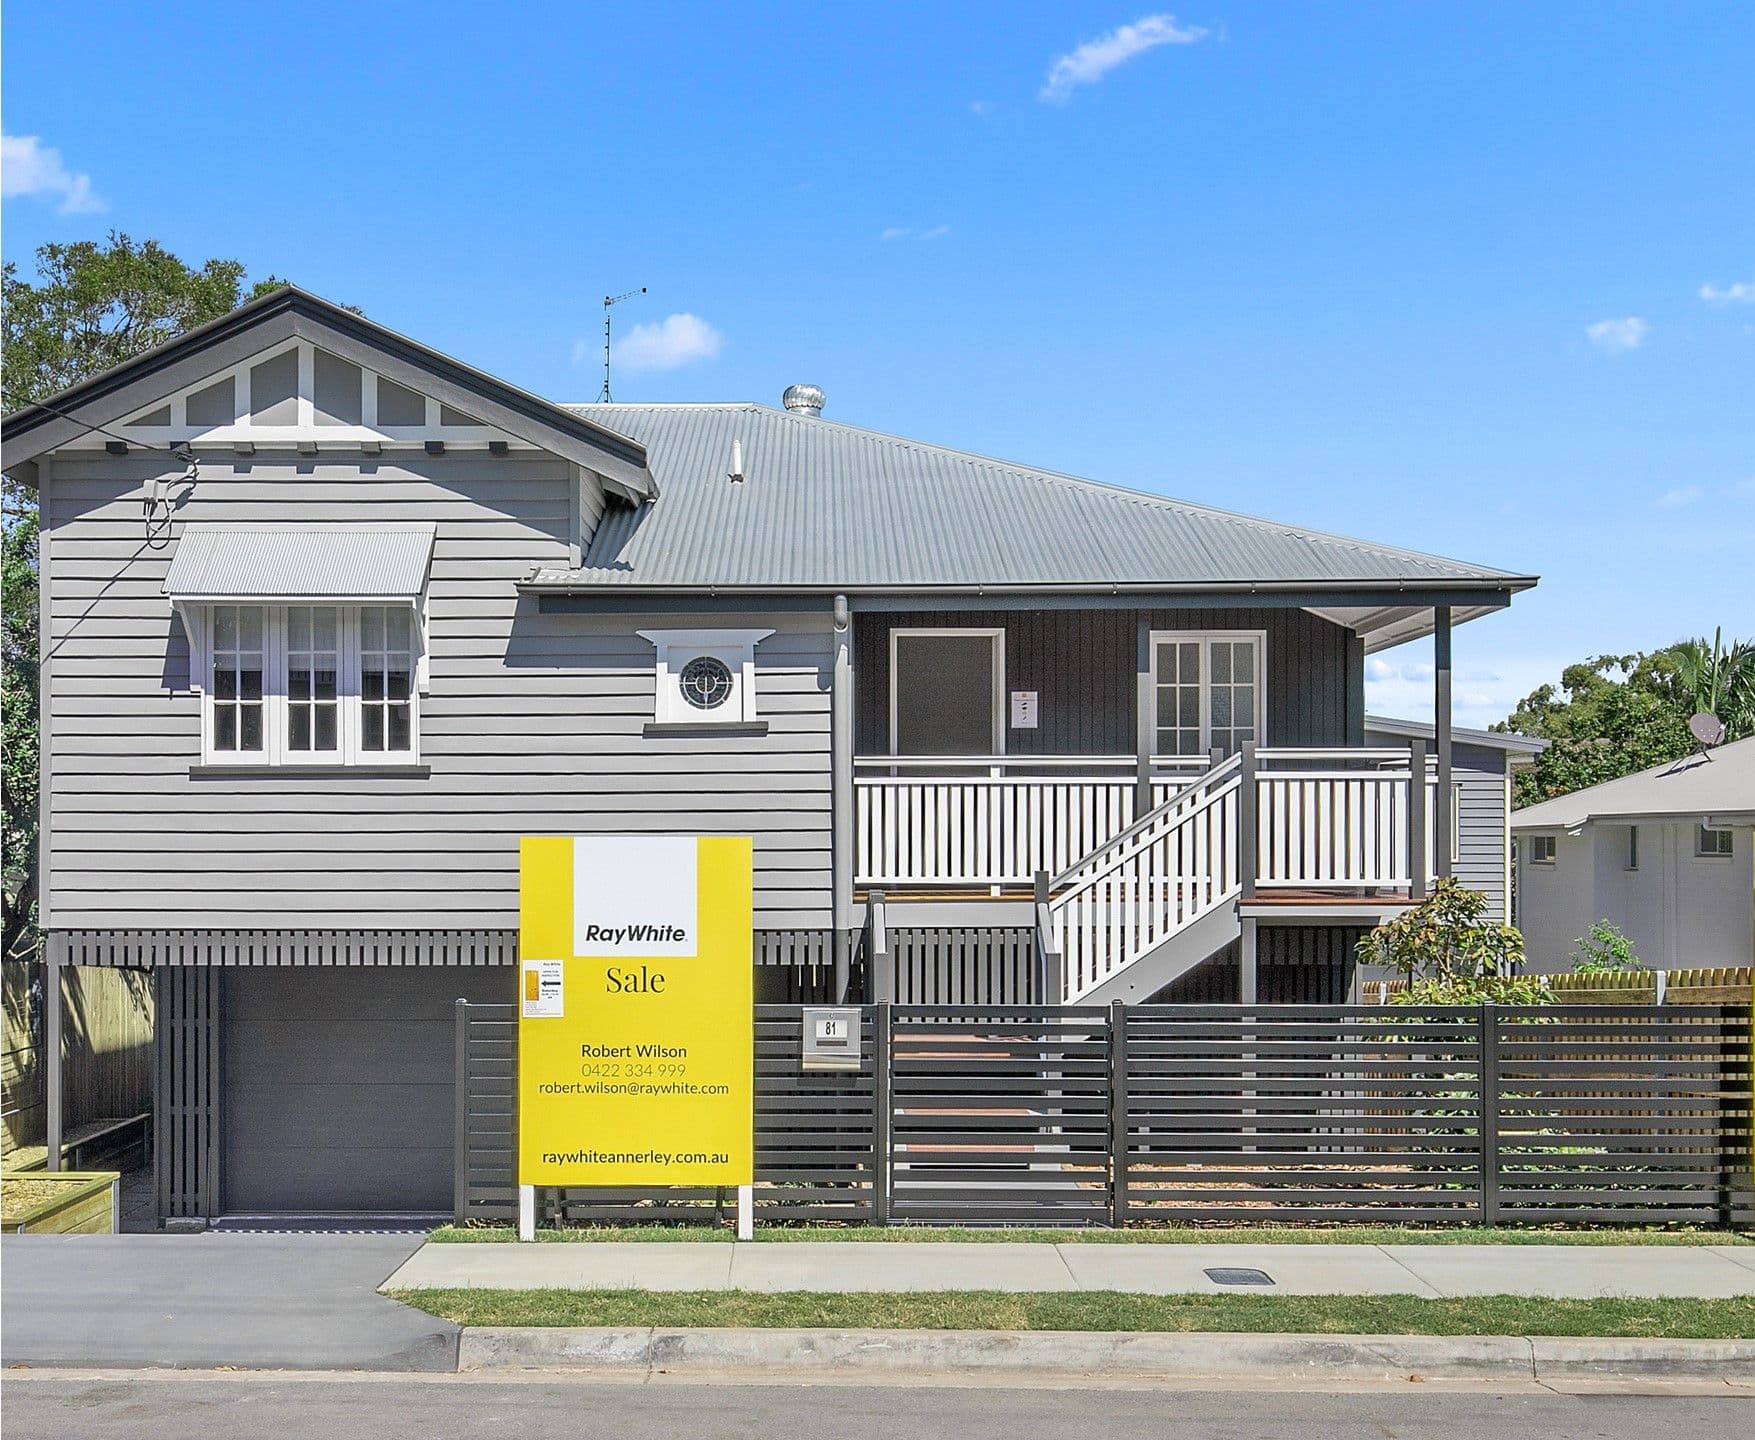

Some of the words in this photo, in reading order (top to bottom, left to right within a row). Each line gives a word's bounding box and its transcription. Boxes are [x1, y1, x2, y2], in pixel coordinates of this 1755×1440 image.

[606, 965, 666, 994] Sale
[825, 1021, 836, 1035] 81
[581, 1043, 632, 1058] Robert
[635, 1043, 687, 1058] Wilson
[581, 1063, 620, 1077] 0422
[624, 1063, 654, 1077] 334
[657, 1063, 687, 1077] 999
[539, 1080, 729, 1097] robert.wilson@raywhite.com
[542, 1149, 729, 1167] raywhiteannerley.com.au
